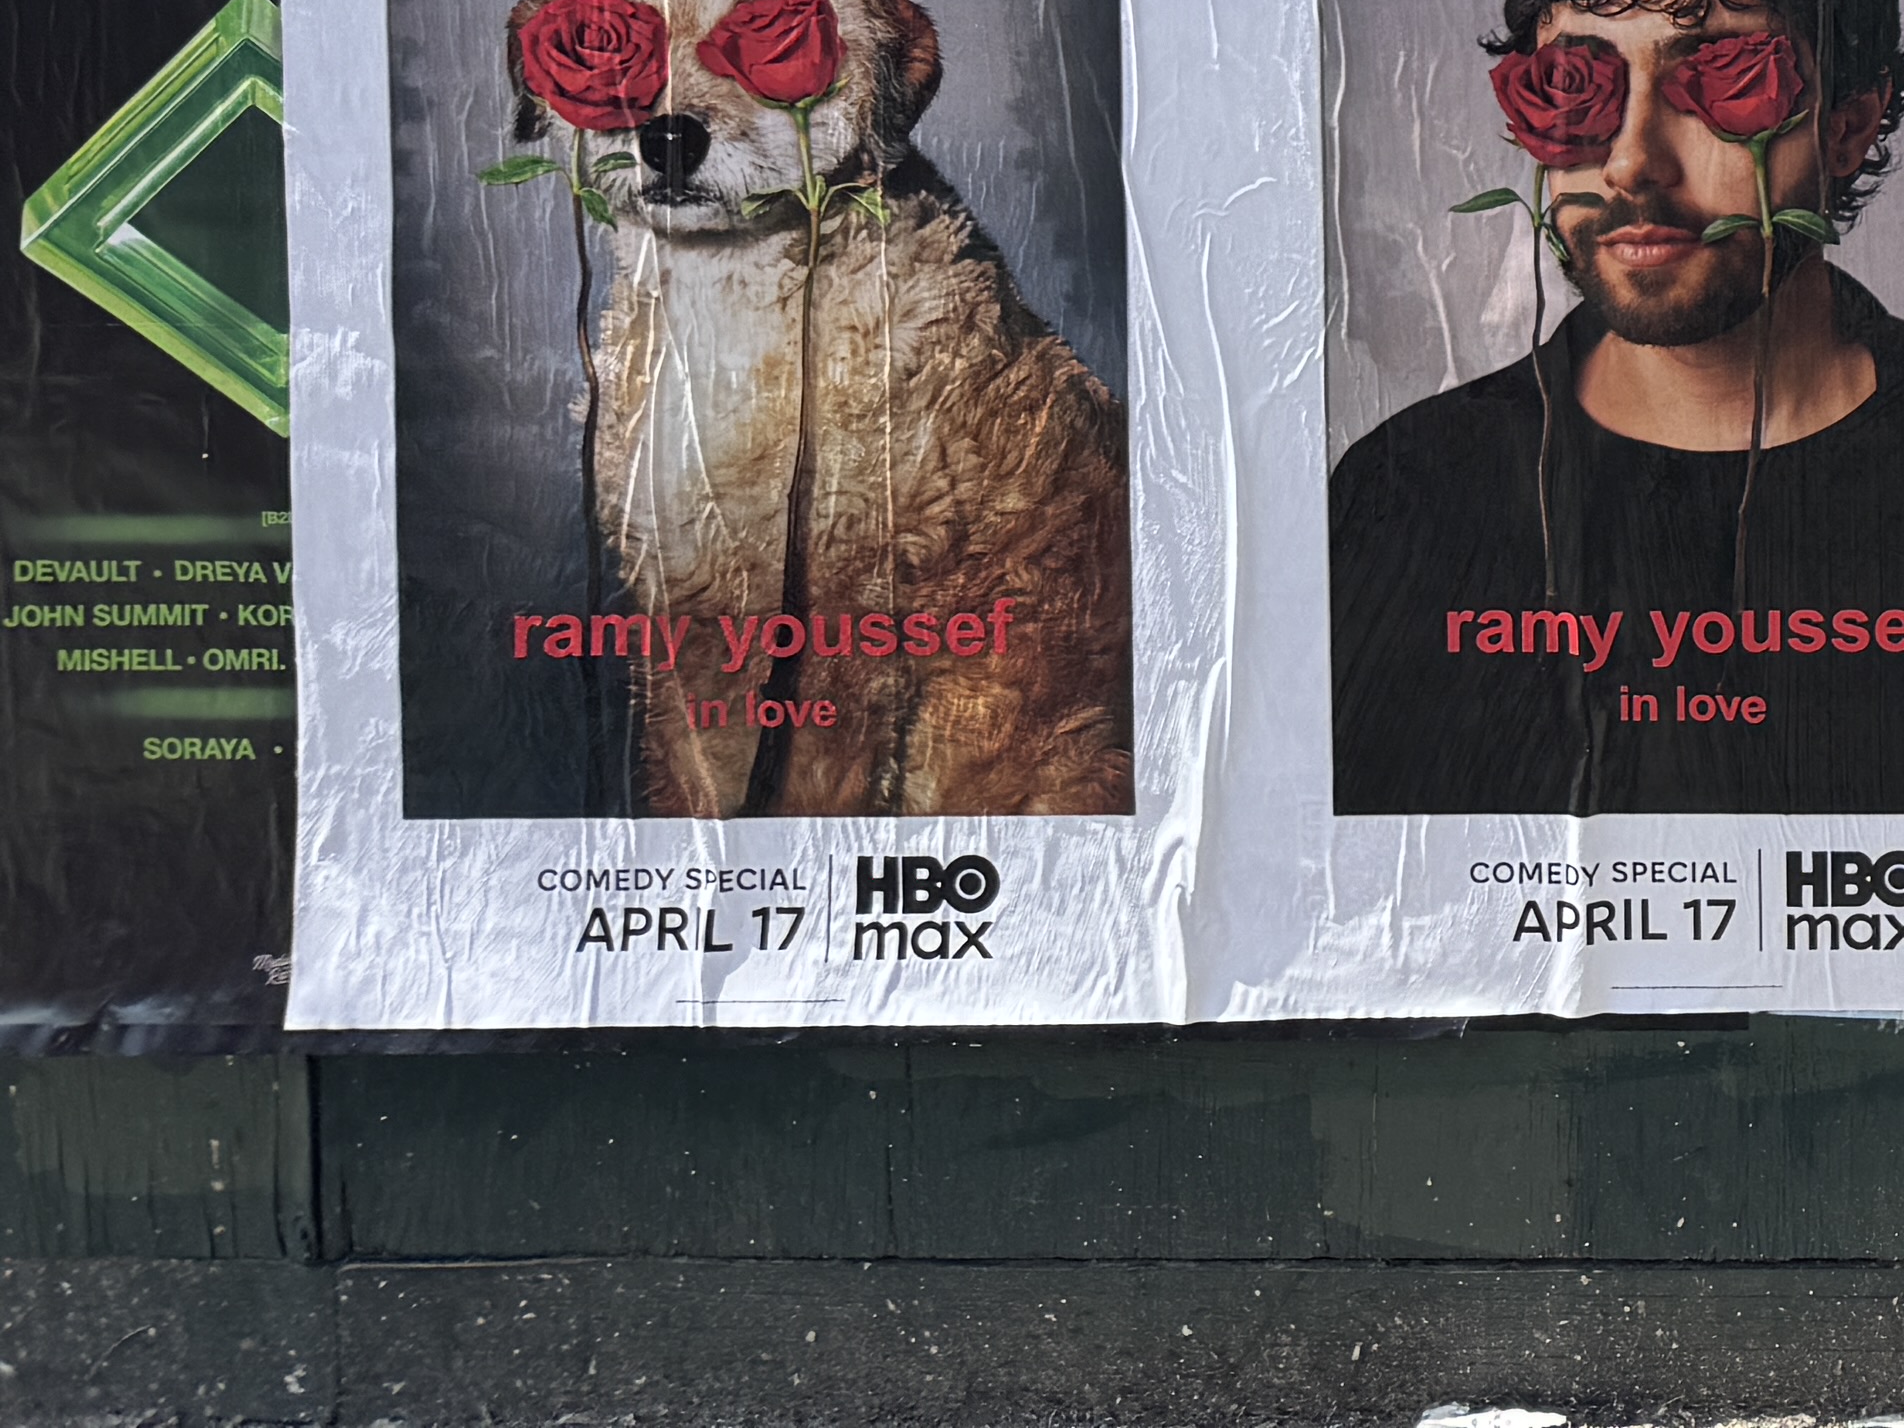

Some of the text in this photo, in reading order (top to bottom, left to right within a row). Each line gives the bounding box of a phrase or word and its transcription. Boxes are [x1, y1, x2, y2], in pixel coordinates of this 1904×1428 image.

[13, 560, 292, 584] DEVAULT DREYA V
[3, 605, 85, 627] JOHN
[92, 604, 209, 627] SUMMIT
[512, 598, 1014, 674] ramy youssef
[1446, 610, 1623, 674] ramy
[57, 649, 286, 671] MISHELL OMRI.
[687, 691, 837, 729] in love
[1620, 686, 1767, 724] in love
[143, 738, 256, 760] SORAYA
[537, 867, 806, 893] COMEDY SPECIAL
[855, 854, 999, 914] HBO
[1469, 861, 1737, 887] COMEDY SPECIAL
[576, 907, 806, 953] APRIL 17
[853, 920, 993, 960] max
[1512, 900, 1737, 946] APRIL 17
